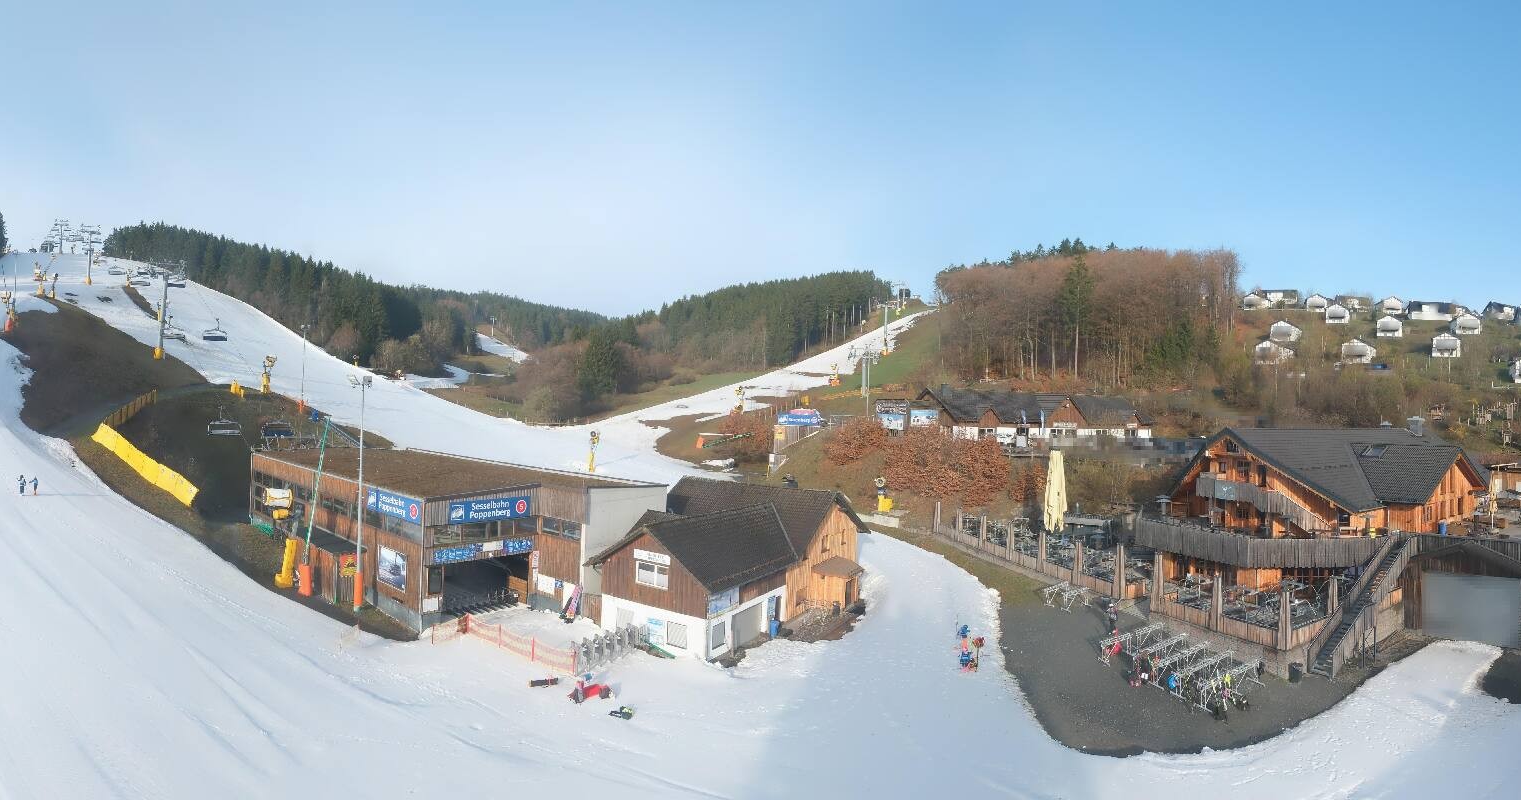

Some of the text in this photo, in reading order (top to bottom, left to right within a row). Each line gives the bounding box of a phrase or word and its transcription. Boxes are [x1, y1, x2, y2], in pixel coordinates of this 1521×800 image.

[379, 493, 405, 508] Sesselbahn
[471, 500, 510, 511] Sesselbahn
[378, 501, 406, 518] Poppenberg
[469, 508, 511, 520] Poppenberg
